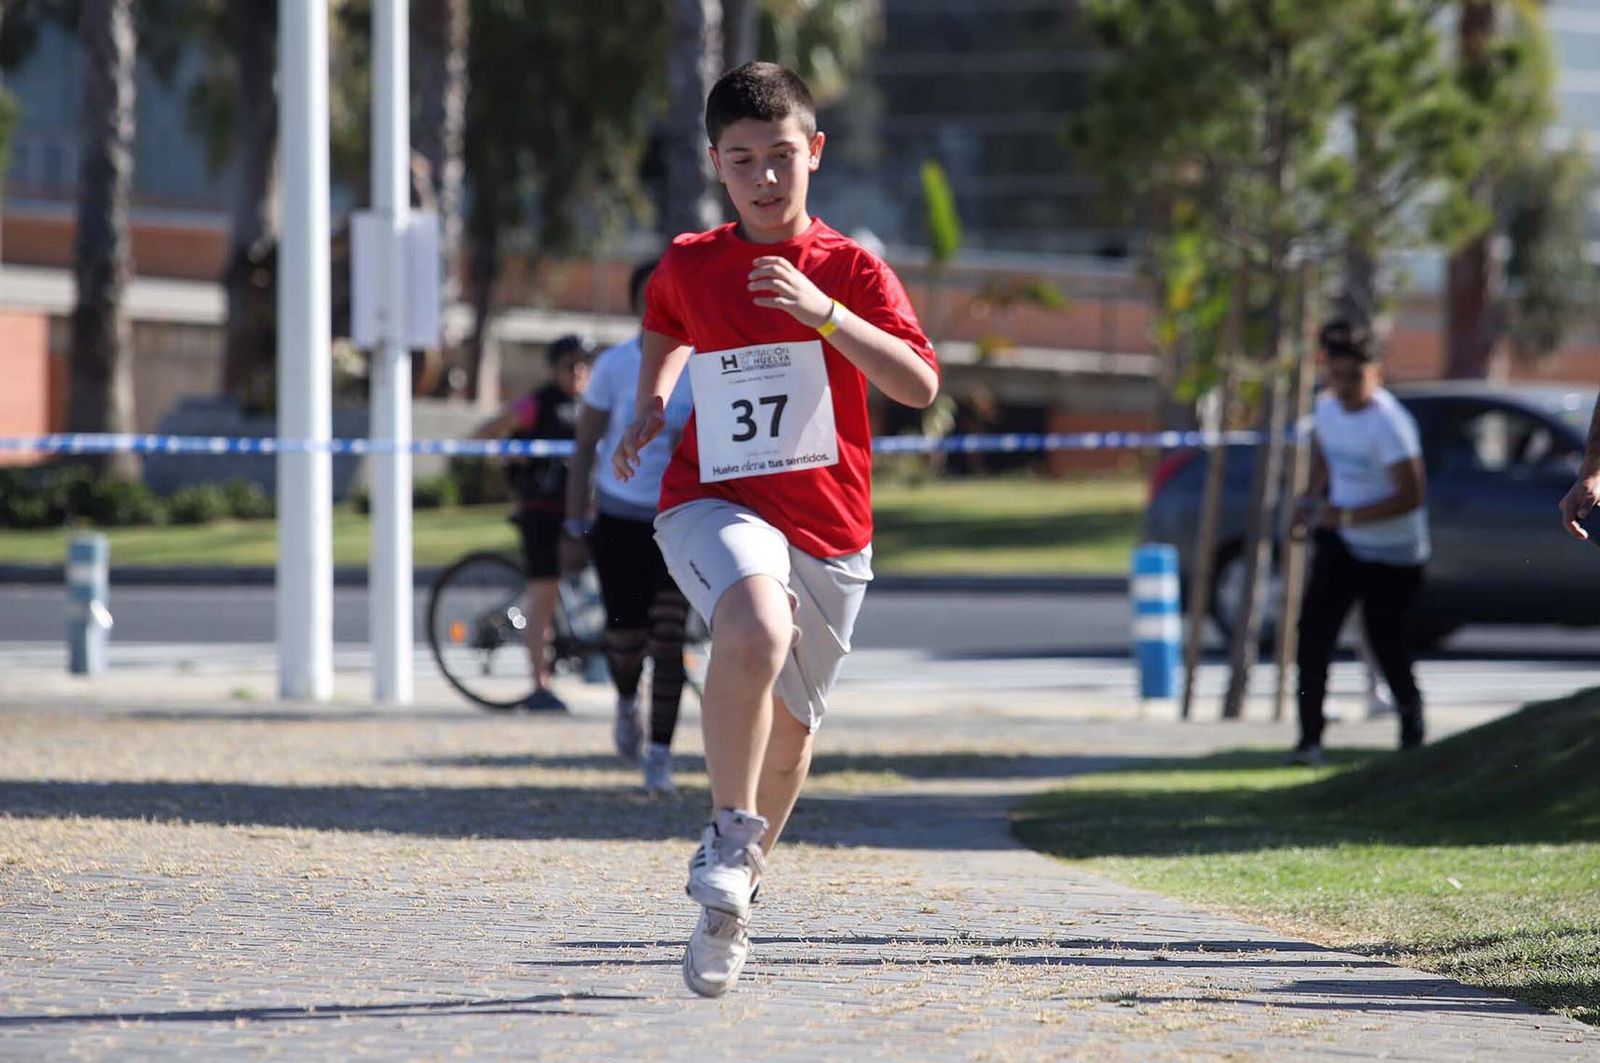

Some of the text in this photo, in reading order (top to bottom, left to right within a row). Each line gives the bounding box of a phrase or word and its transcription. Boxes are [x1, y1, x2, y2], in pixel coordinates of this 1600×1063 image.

[721, 354, 738, 370] H
[753, 355, 790, 364] HUELVA
[731, 394, 788, 442] 37
[712, 465, 739, 476] Huelva
[768, 459, 784, 469] tus
